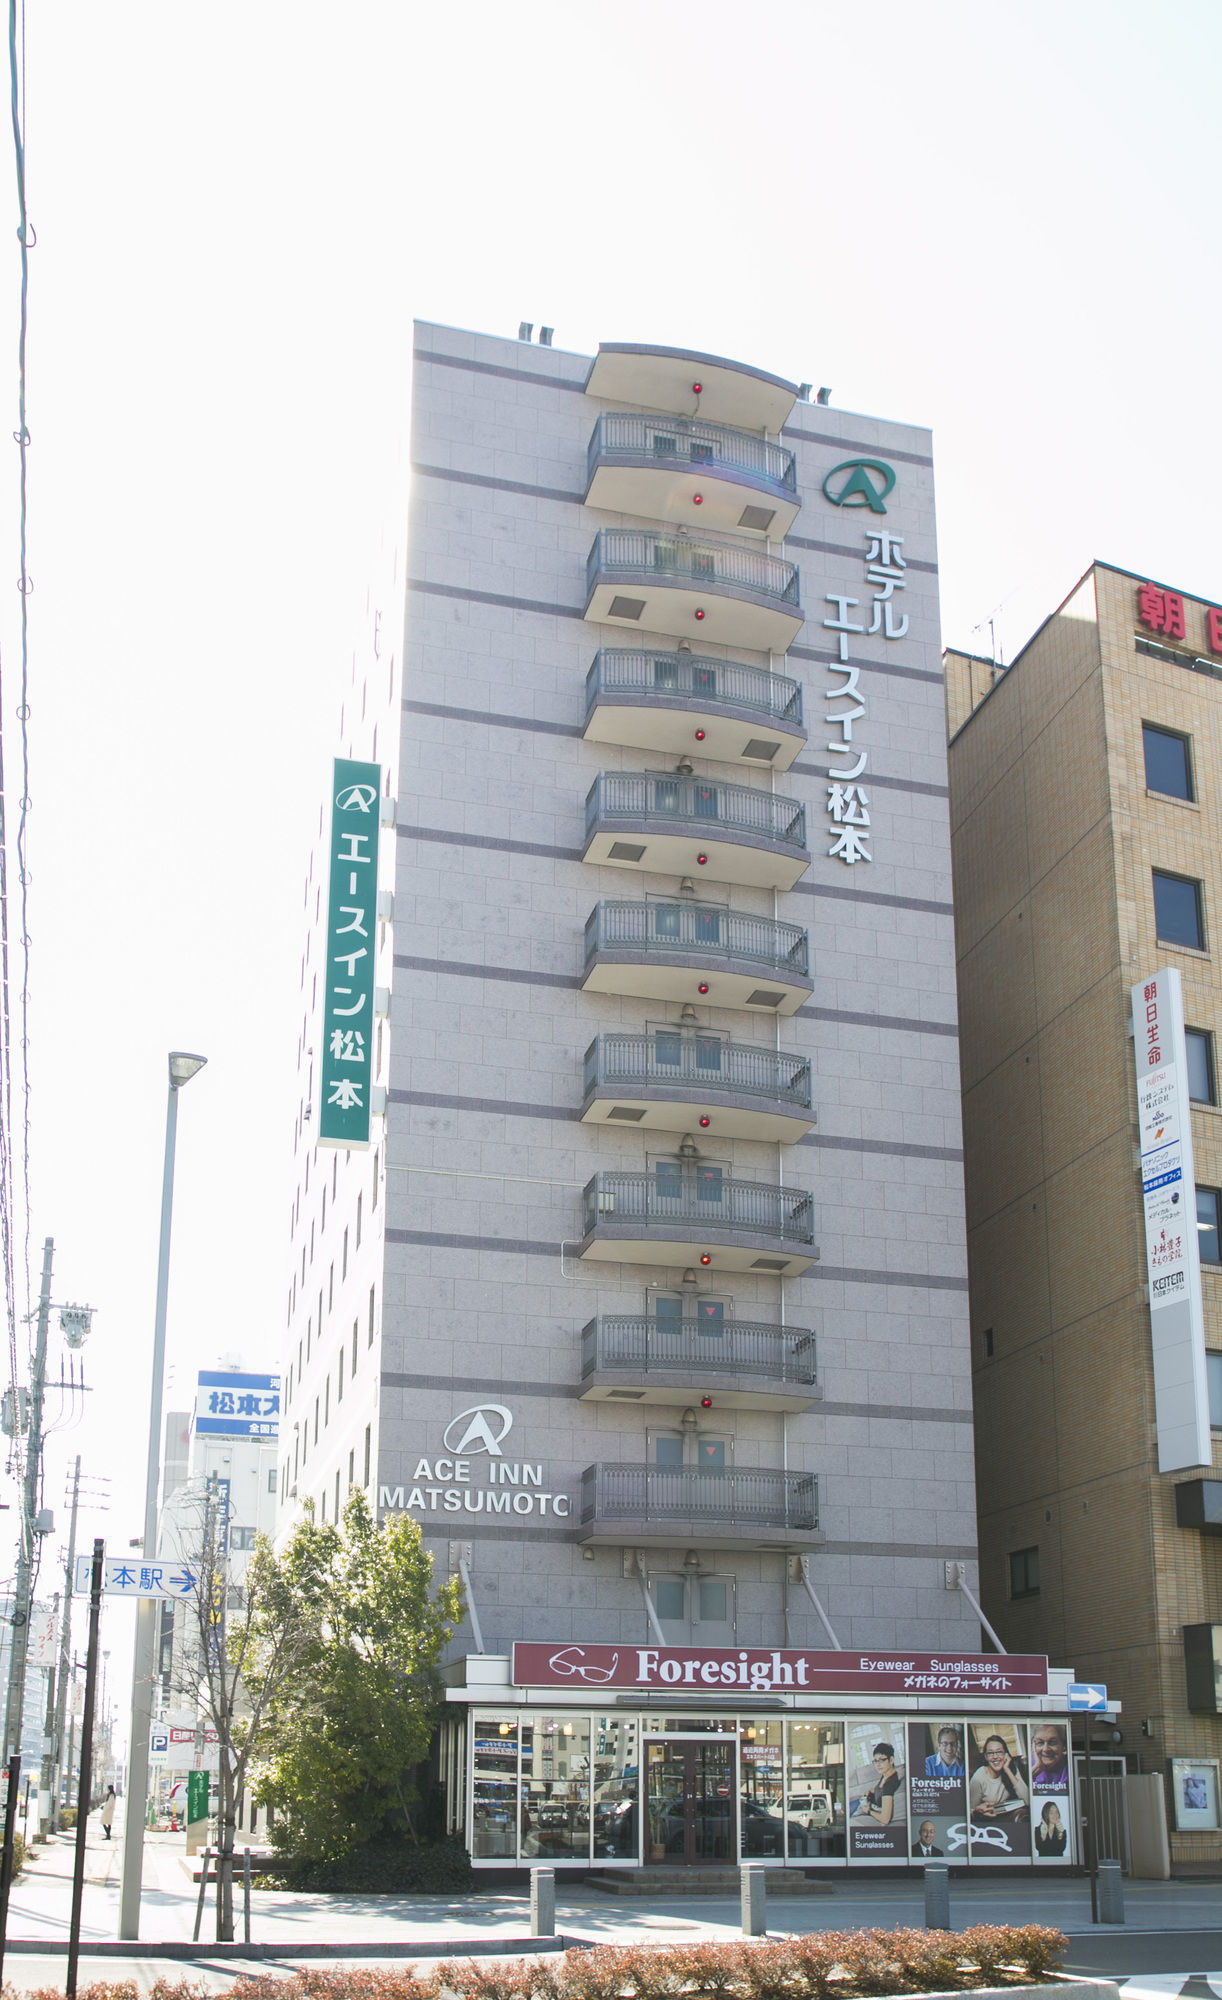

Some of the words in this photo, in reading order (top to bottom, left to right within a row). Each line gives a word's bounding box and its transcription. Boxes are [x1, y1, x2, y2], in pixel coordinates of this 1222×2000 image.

[866, 530, 909, 640] ホテル
[823, 593, 873, 865] エースイン松本
[327, 832, 371, 1110] エースイン松本
[1144, 981, 1161, 1066] 朝日生命
[413, 1458, 470, 1482] ACE
[489, 1462, 543, 1486] INN
[636, 1650, 810, 1691] Foresight
[860, 1658, 915, 1671] Eyewear
[930, 1659, 999, 1673] Sunglasses
[904, 1675, 1012, 1690] メガネのフォーサイト
[911, 1777, 961, 1790] Foresight
[1032, 1781, 1067, 1791] Foresight
[855, 1832, 885, 1841] Eyewear
[855, 1841, 895, 1850] Sunglasses
